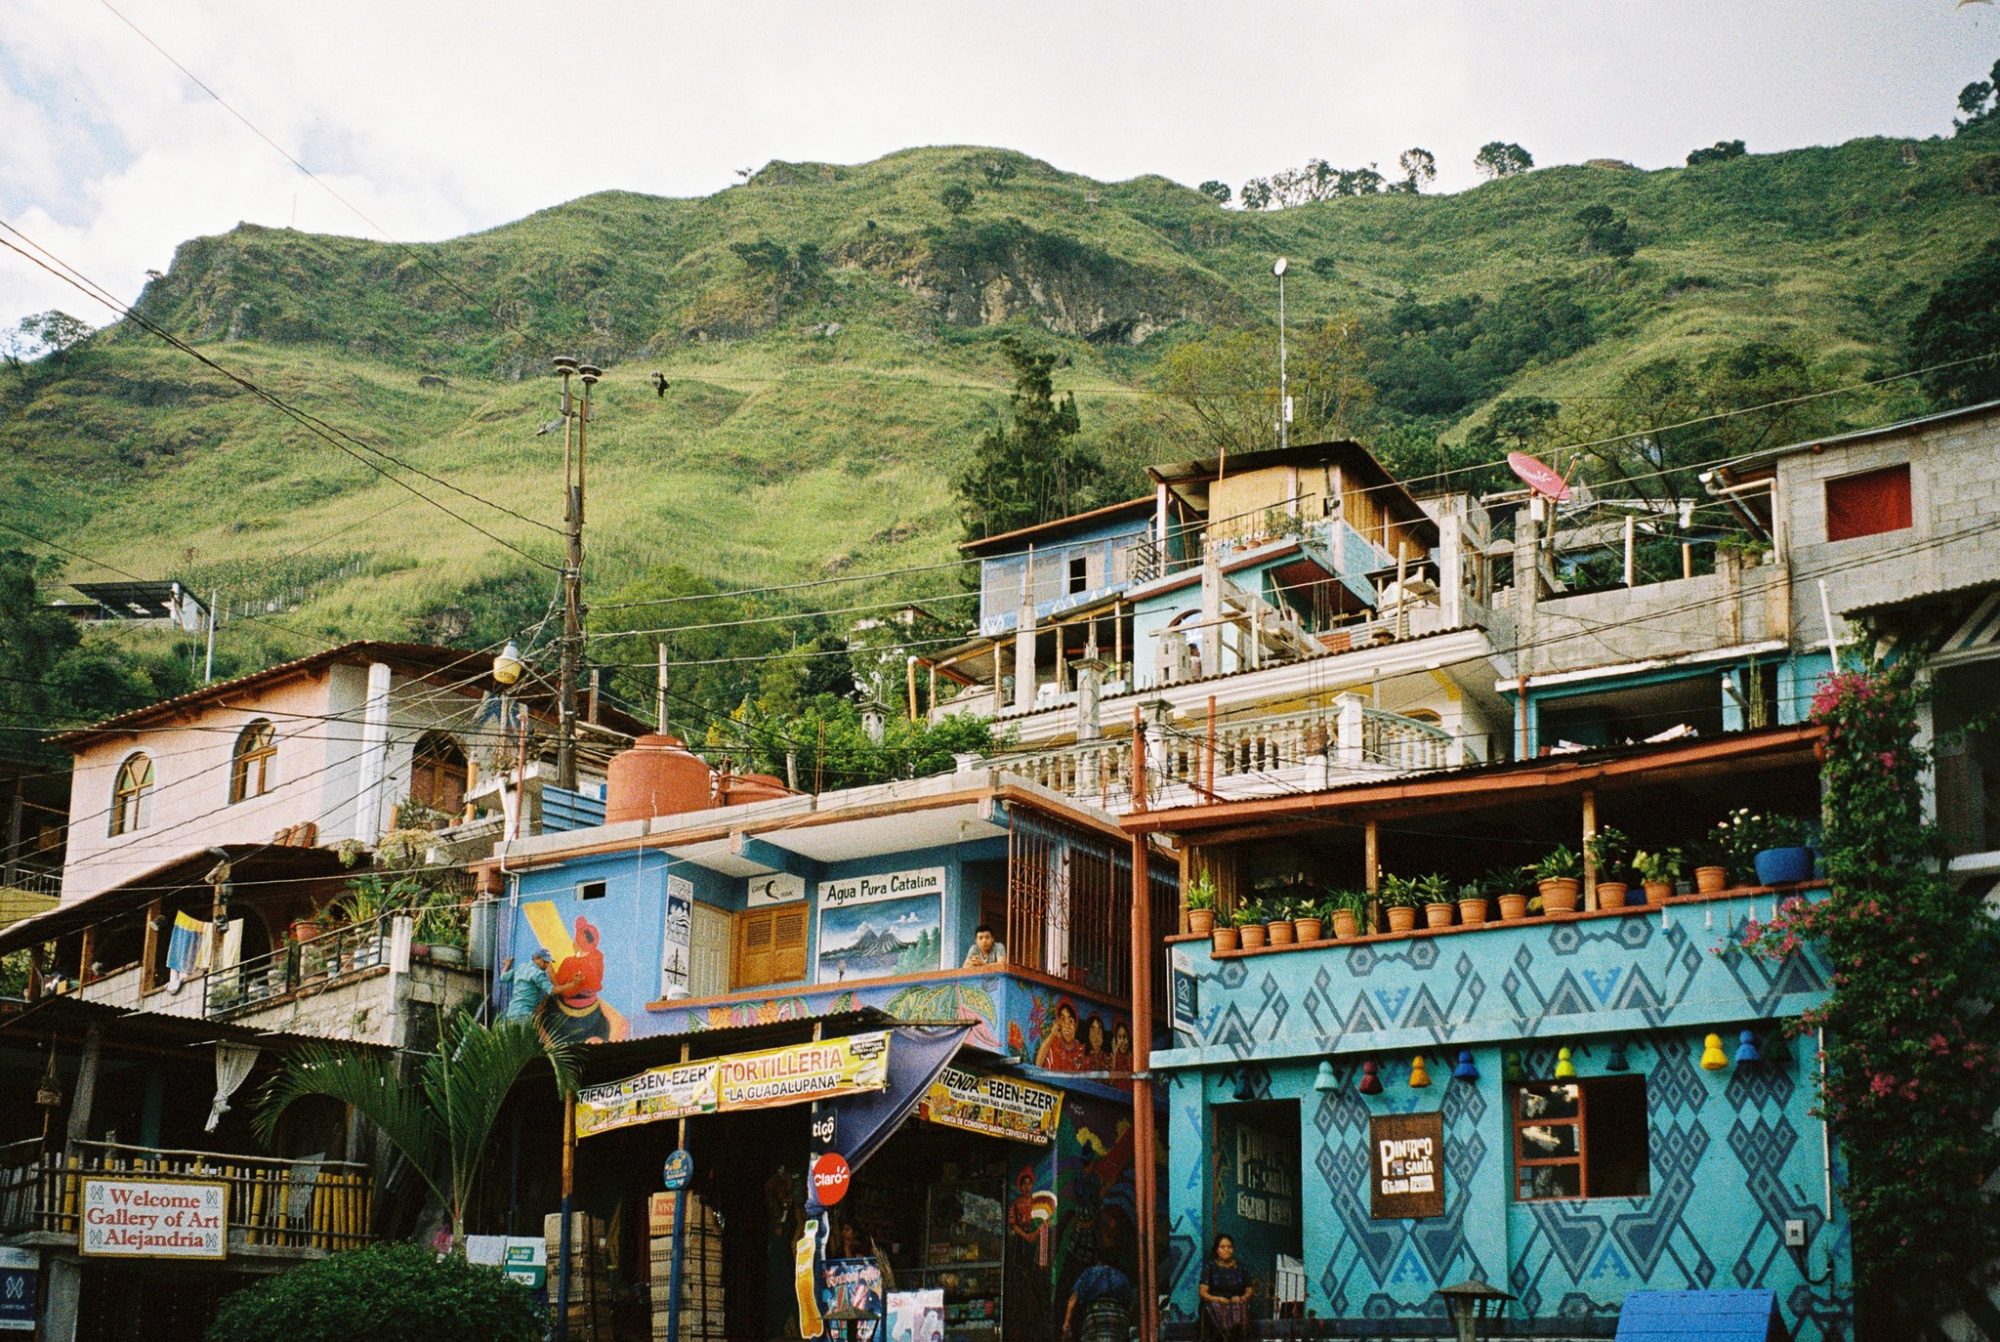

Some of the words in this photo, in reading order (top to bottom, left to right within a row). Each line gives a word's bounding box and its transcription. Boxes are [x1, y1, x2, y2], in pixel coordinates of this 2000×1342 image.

[826, 884, 856, 905] Agua
[861, 880, 887, 896] Pura
[890, 876, 937, 892] Catalina
[721, 1047, 843, 1084] TORTILLERIA
[578, 1084, 623, 1104] TIENDA
[812, 1116, 834, 1143] tigo
[1405, 1156, 1434, 1175] SANTA
[814, 1172, 843, 1187] Claro
[110, 1188, 200, 1209] Welcome
[87, 1208, 159, 1230] Gallery
[164, 1211, 184, 1228] of
[187, 1212, 219, 1229] Art
